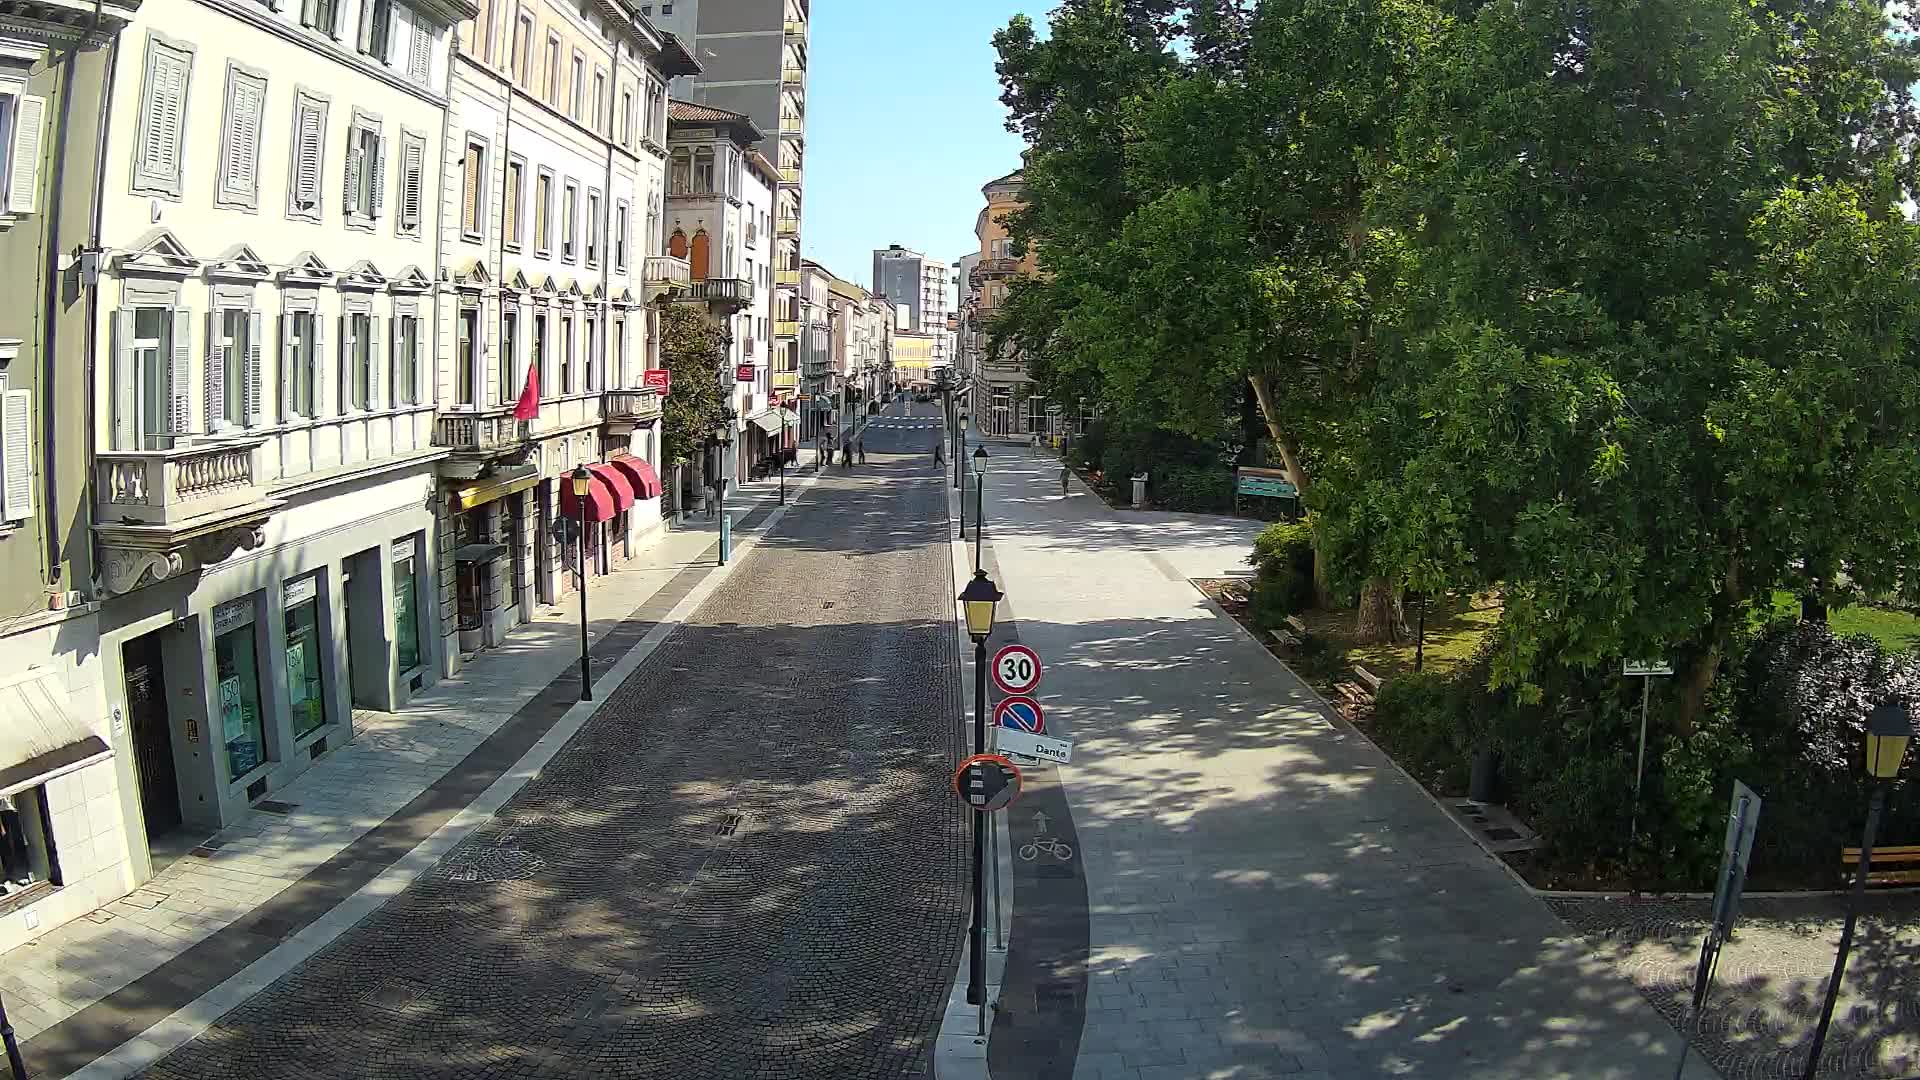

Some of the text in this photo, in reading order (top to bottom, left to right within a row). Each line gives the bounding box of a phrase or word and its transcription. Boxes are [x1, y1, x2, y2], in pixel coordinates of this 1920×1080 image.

[1003, 659, 1032, 681] 30
[221, 679, 239, 702] 130
[1036, 744, 1066, 758] Dante
